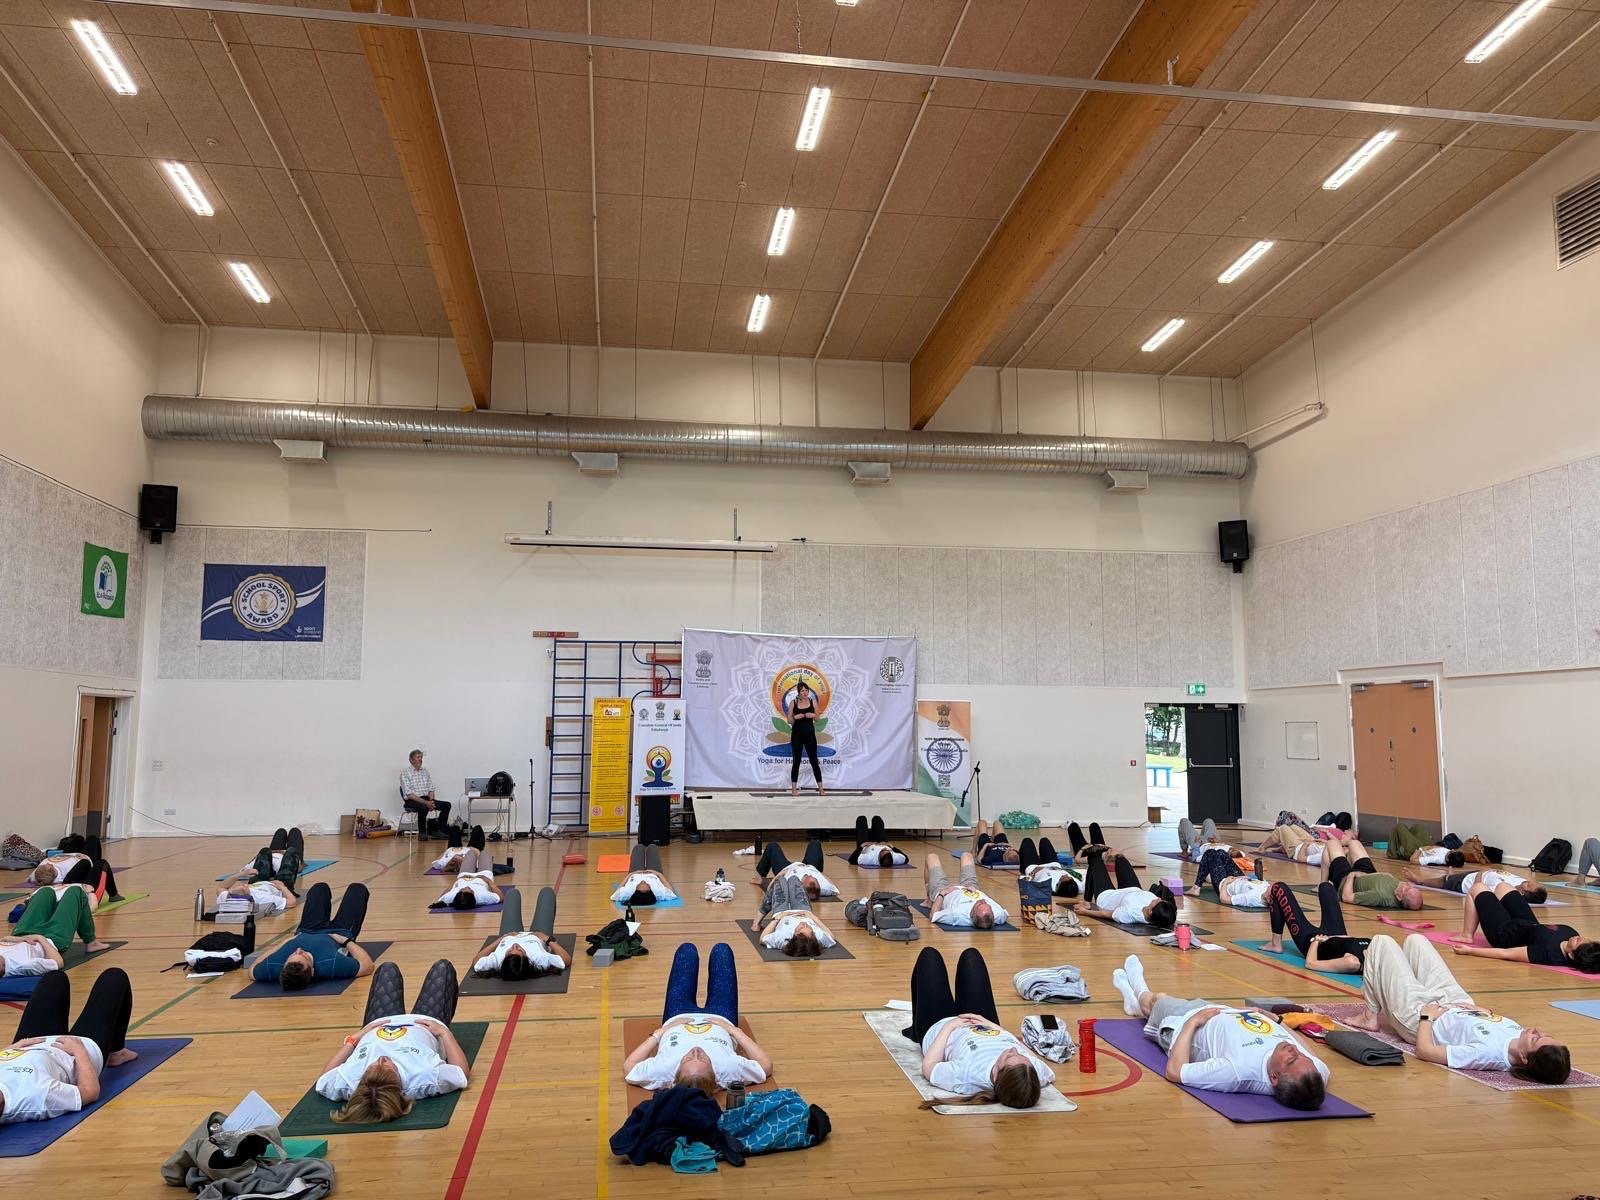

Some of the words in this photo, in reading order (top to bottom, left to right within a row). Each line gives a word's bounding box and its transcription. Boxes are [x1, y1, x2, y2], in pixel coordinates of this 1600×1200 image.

[242, 582, 266, 602] SCHOOL
[268, 583, 286, 603] SPORT
[247, 613, 278, 623] AWARD
[758, 757, 773, 765] Yoga
